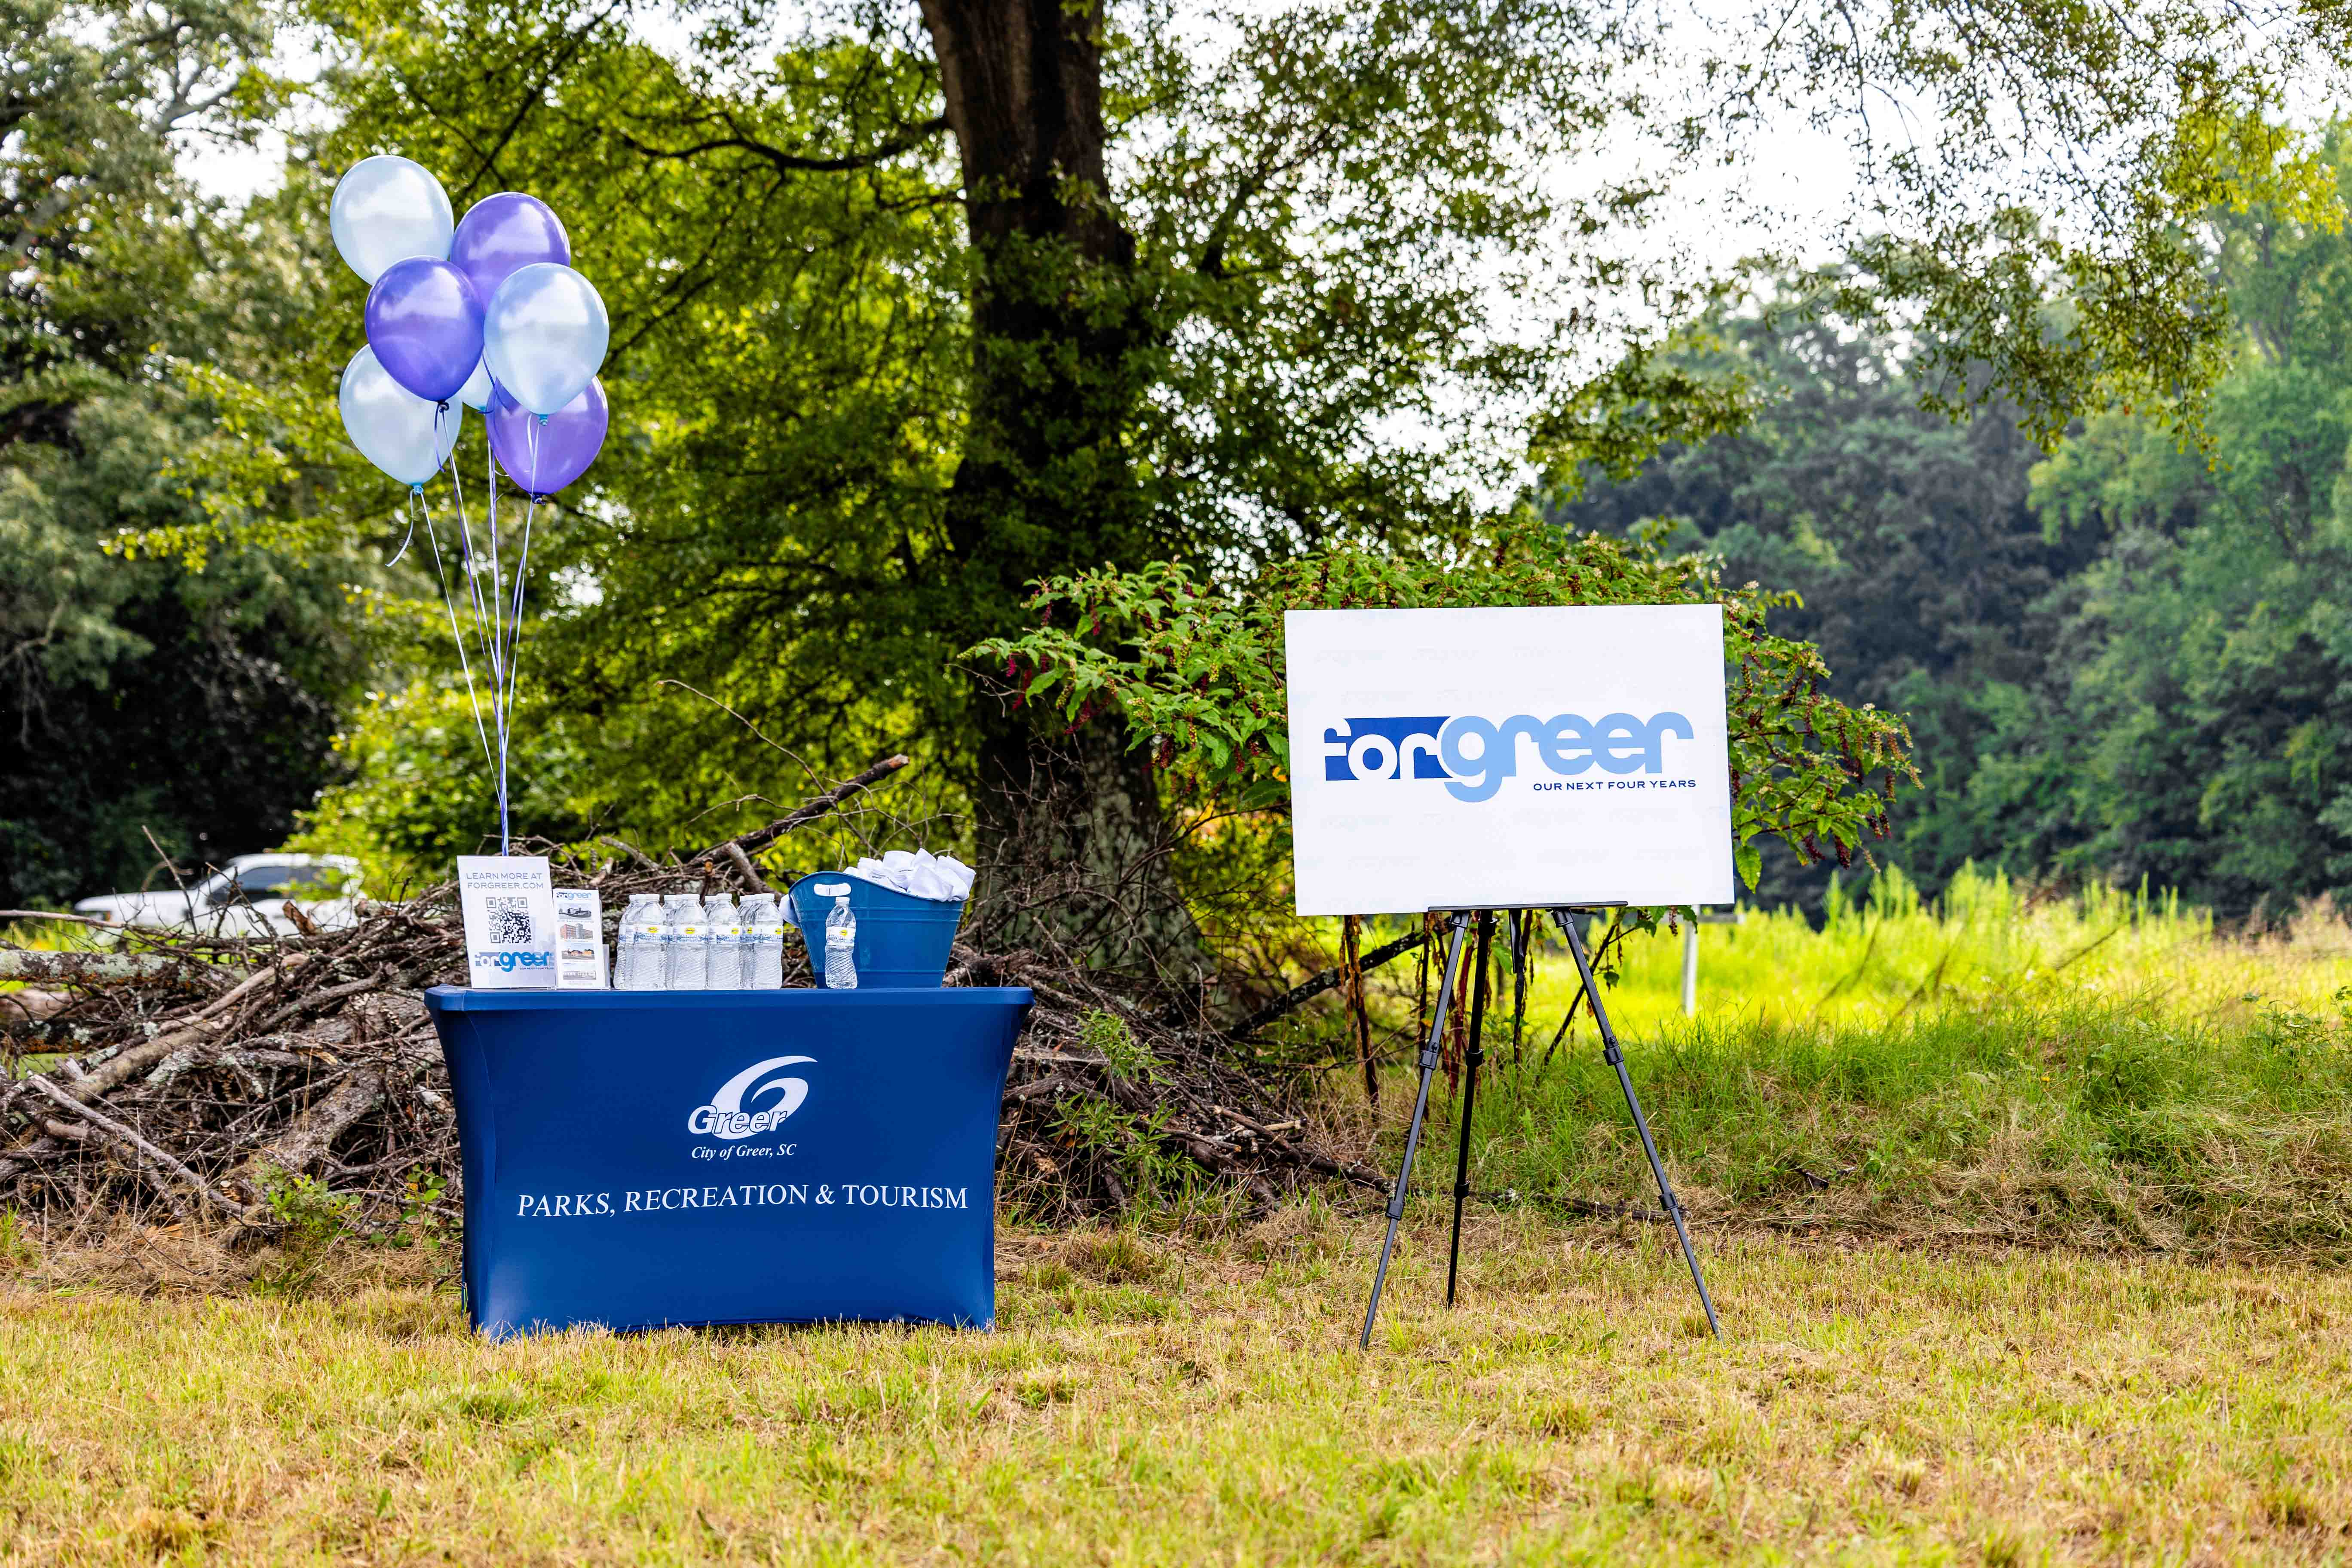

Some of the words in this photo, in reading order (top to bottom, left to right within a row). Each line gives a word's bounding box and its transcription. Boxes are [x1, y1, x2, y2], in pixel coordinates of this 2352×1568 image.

[1608, 781, 1645, 789] FOUR
[1650, 780, 1697, 788] YEARS
[688, 1105, 787, 1134] Greer
[691, 1146, 717, 1161] City
[719, 1145, 735, 1161] of
[736, 1145, 773, 1158] Greer,
[777, 1143, 797, 1156] SC
[516, 1193, 616, 1217] PARKS,
[622, 1184, 810, 1212] RECREATION
[815, 1184, 836, 1204] &
[842, 1185, 969, 1209] TOURISM
